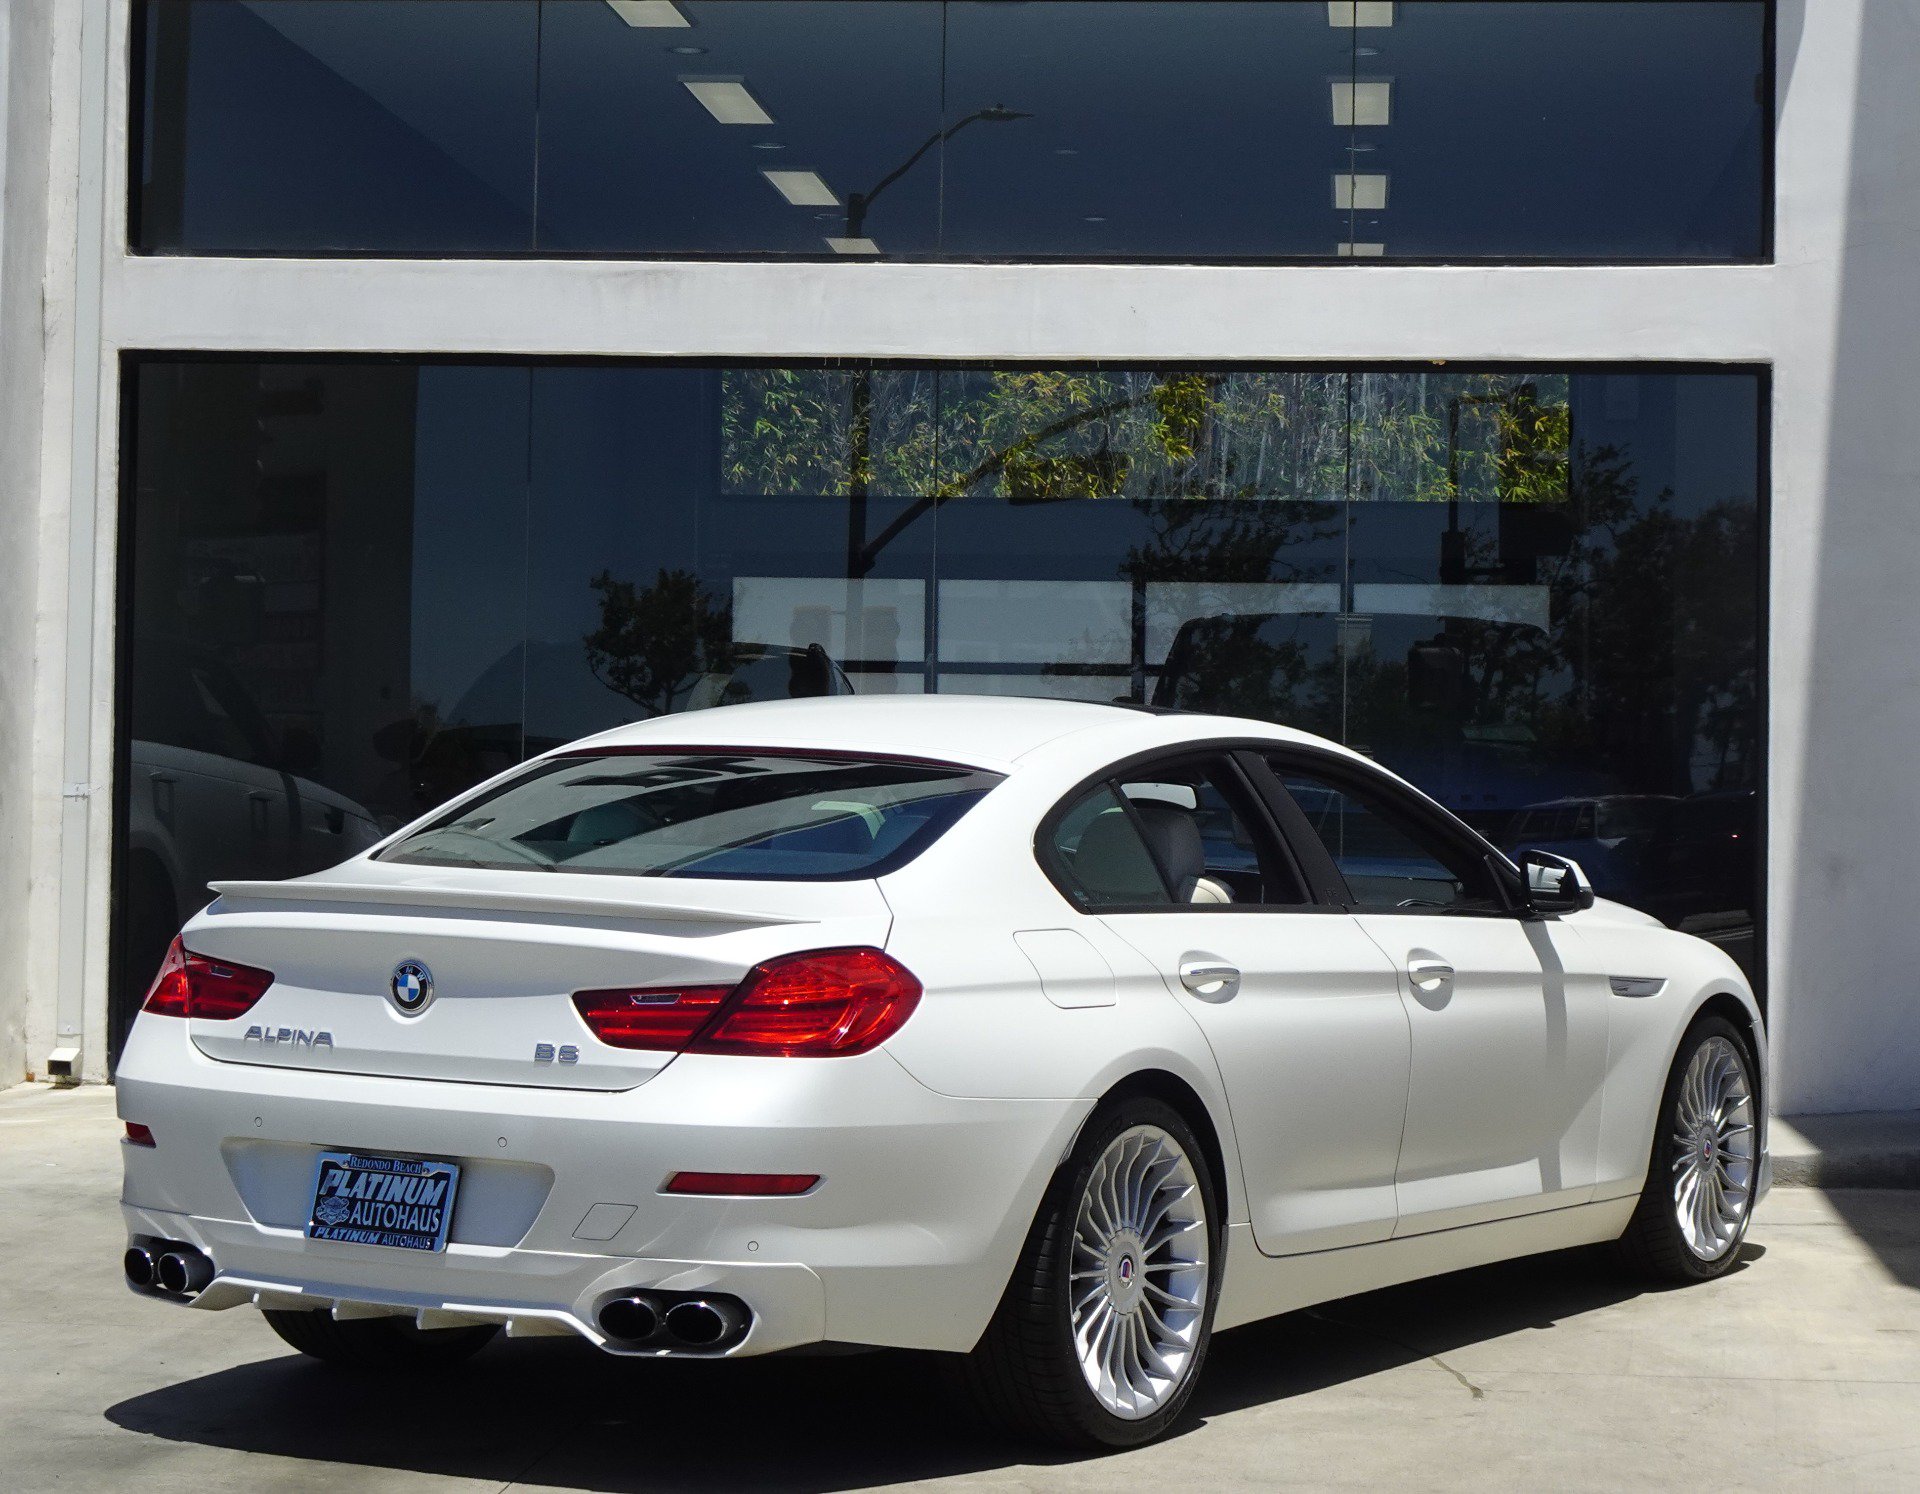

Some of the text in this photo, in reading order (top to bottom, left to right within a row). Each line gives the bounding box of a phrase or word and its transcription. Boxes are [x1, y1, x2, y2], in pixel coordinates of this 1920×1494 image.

[395, 966, 426, 981] BMW
[244, 1026, 333, 1048] ALPINA
[534, 1043, 579, 1062] B6
[350, 1156, 422, 1174] REDONDO BEACH
[320, 1169, 447, 1206] PLATINUM
[350, 1202, 441, 1233] AUTOHAUS
[315, 1227, 430, 1249] PLATINUM AUTOHAUS
